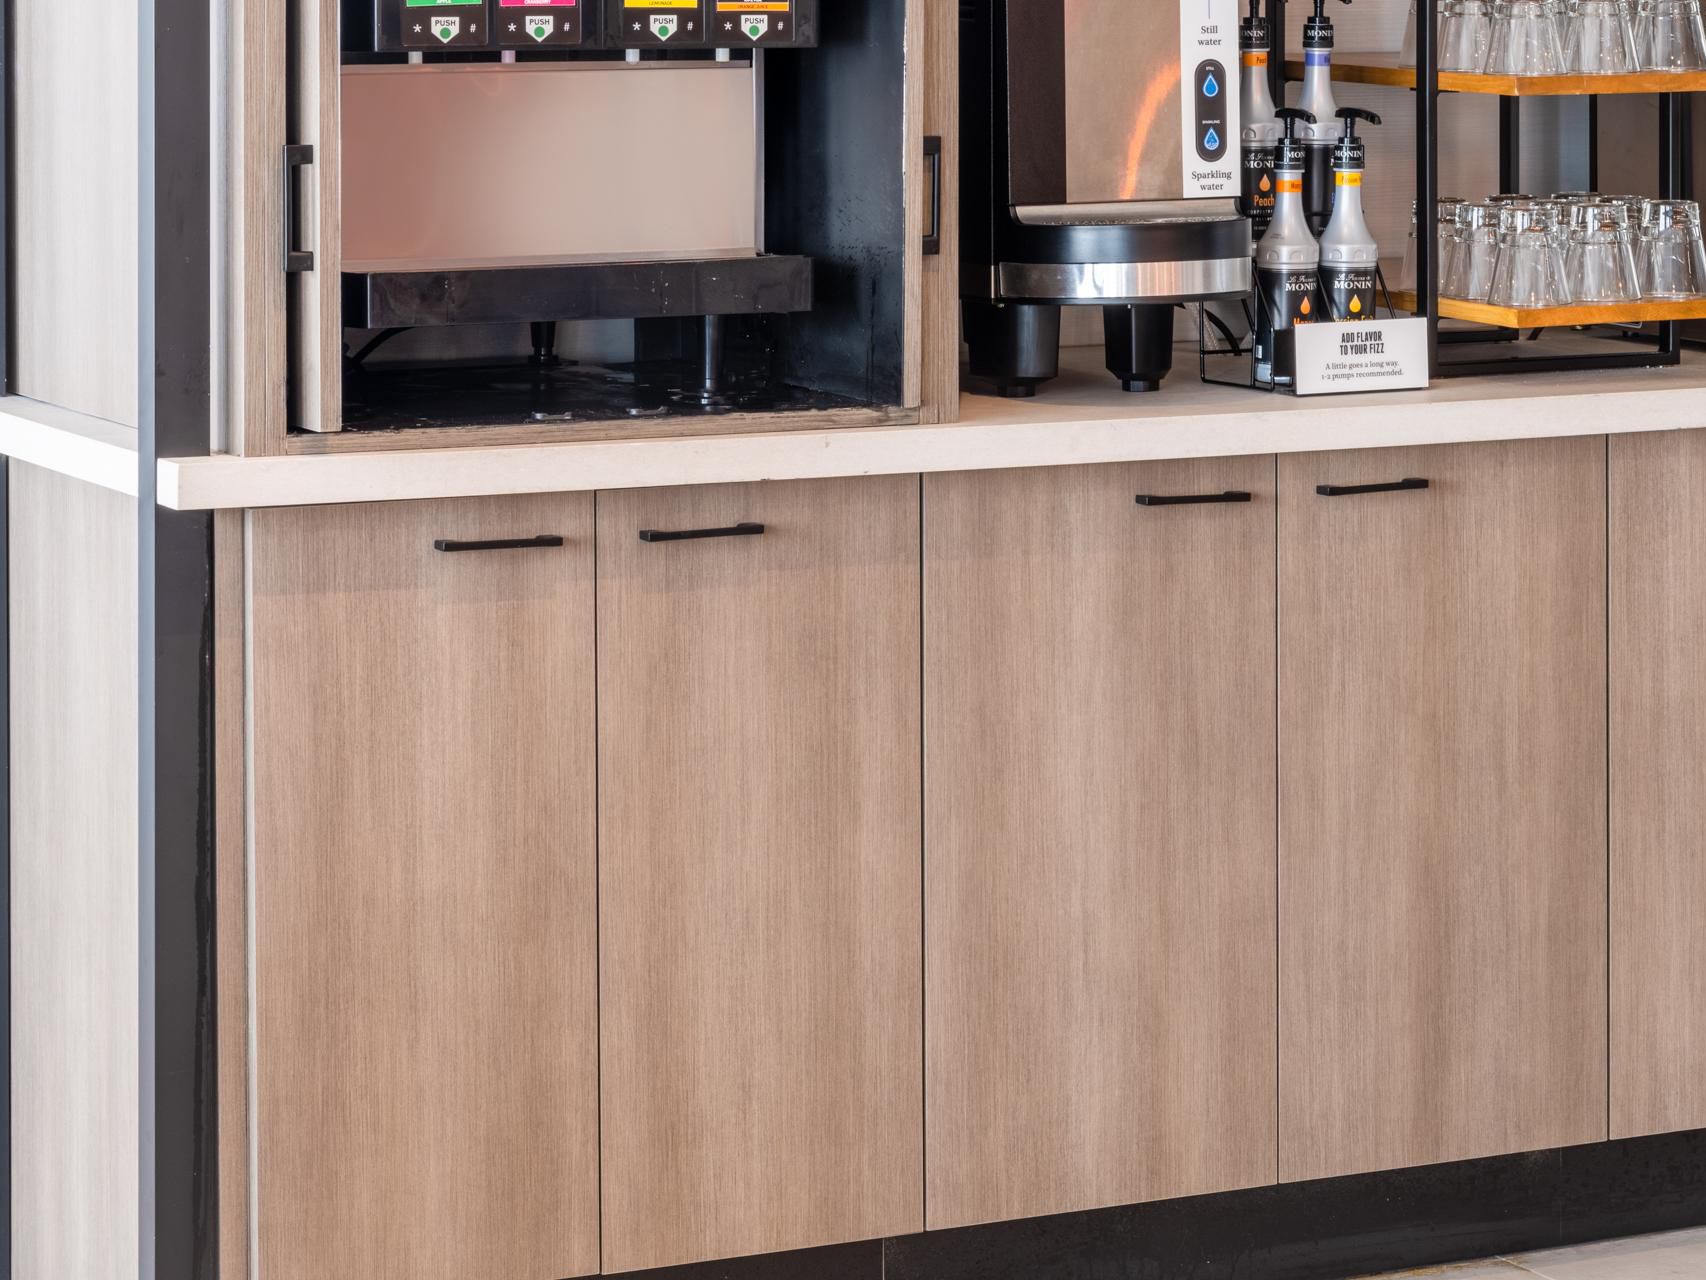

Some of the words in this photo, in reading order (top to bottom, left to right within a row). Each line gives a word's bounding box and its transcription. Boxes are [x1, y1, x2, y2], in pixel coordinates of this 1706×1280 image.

[1201, 25, 1218, 34] Still
[1241, 29, 1265, 37] ONIN
[1307, 29, 1334, 37] MONI
[1287, 151, 1305, 159] MON
[1334, 149, 1362, 158] MONIN
[1244, 160, 1274, 169] MONI
[1191, 170, 1232, 182] Sparkling
[1200, 183, 1224, 192] water
[1253, 194, 1275, 207] Peach
[1285, 282, 1317, 292] MONIN
[1334, 281, 1373, 289] MONIN
[1341, 332, 1355, 344] ADD
[1356, 330, 1383, 343] FLAVOR
[1340, 344, 1349, 356] TO
[1350, 343, 1368, 356] YOUR
[1369, 342, 1385, 354] FIZZ
[1332, 362, 1347, 370] little
[1348, 362, 1363, 371] goes
[1369, 361, 1384, 369] long
[1332, 372, 1355, 381] pumps
[1356, 368, 1404, 378] recommended.
